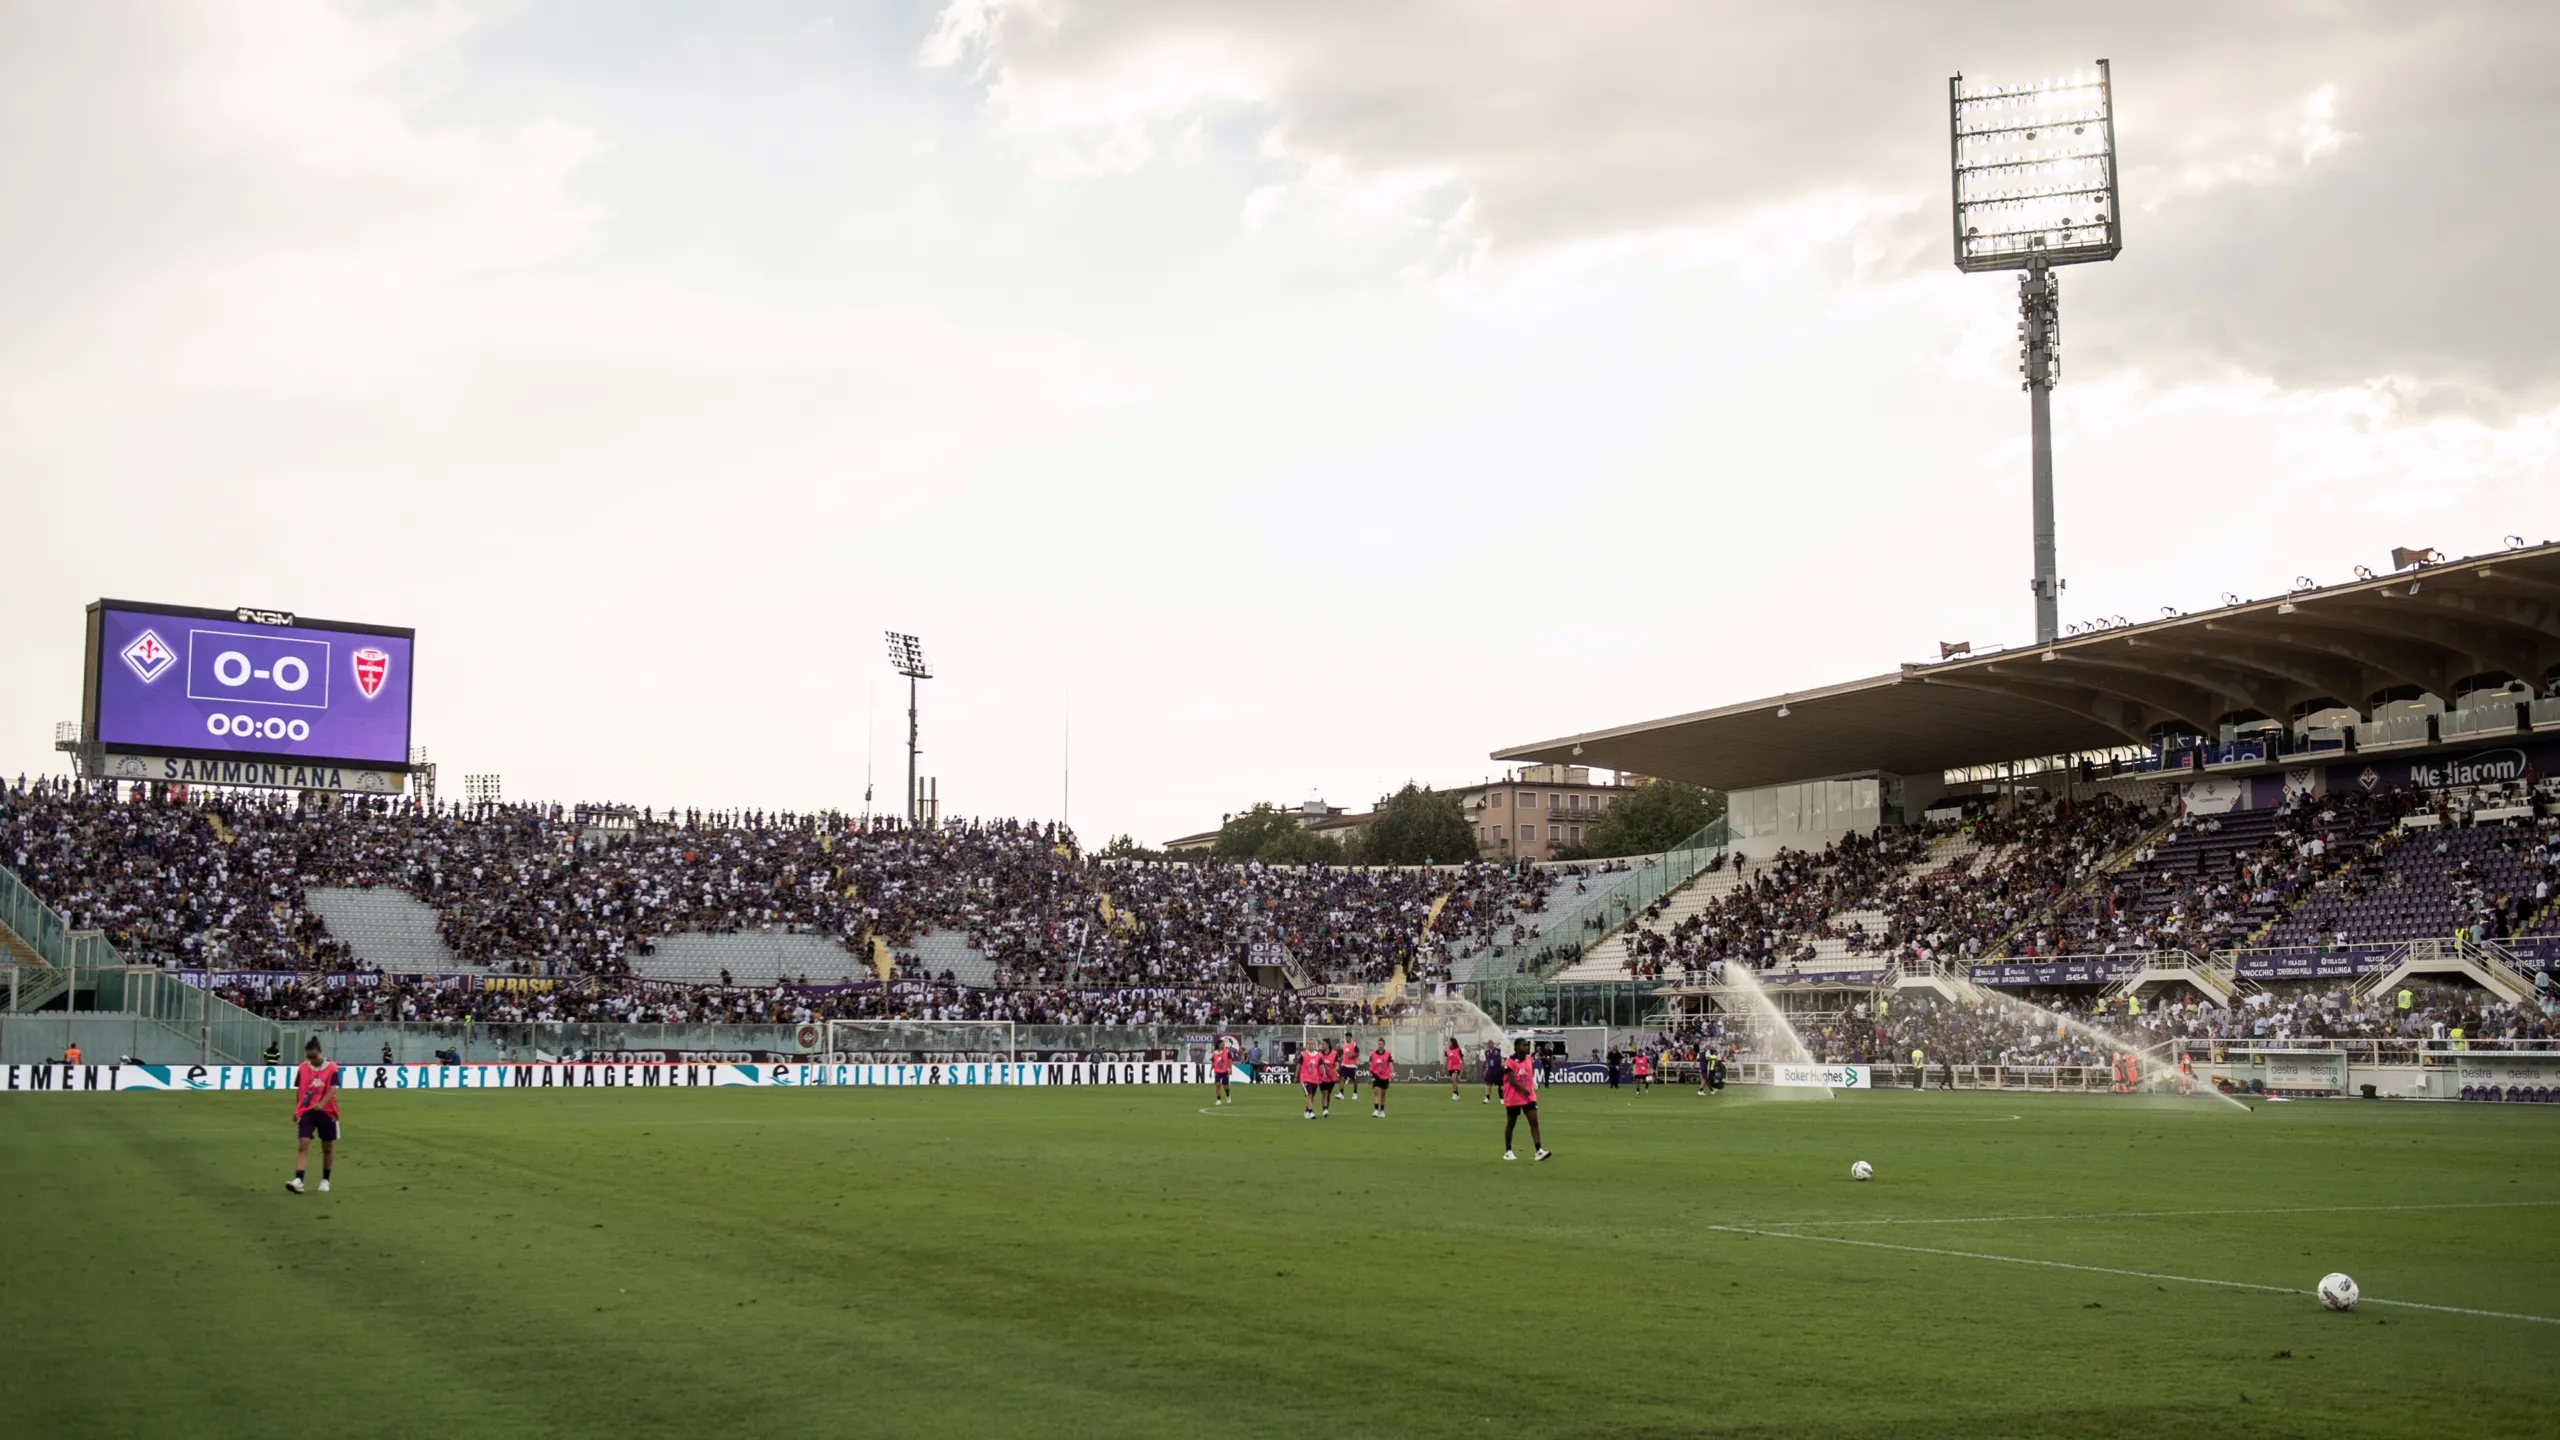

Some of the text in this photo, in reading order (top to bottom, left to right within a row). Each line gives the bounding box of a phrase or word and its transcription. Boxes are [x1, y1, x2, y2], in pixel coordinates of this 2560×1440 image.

[207, 713, 310, 741] 00:00
[164, 757, 342, 789] SAMMONTANA
[2317, 966, 2352, 975] SINALUNGA
[484, 978, 563, 995] MARASM
[1186, 1035, 1212, 1043] TADDO
[8, 1065, 120, 1090] EMENT
[220, 1066, 367, 1090] FACITY
[1048, 1064, 1212, 1084] MANAGEMEN
[1260, 1074, 1292, 1084] 36:13
[1533, 1067, 1604, 1083] Mediacom
[1784, 1068, 1809, 1081] Baker
